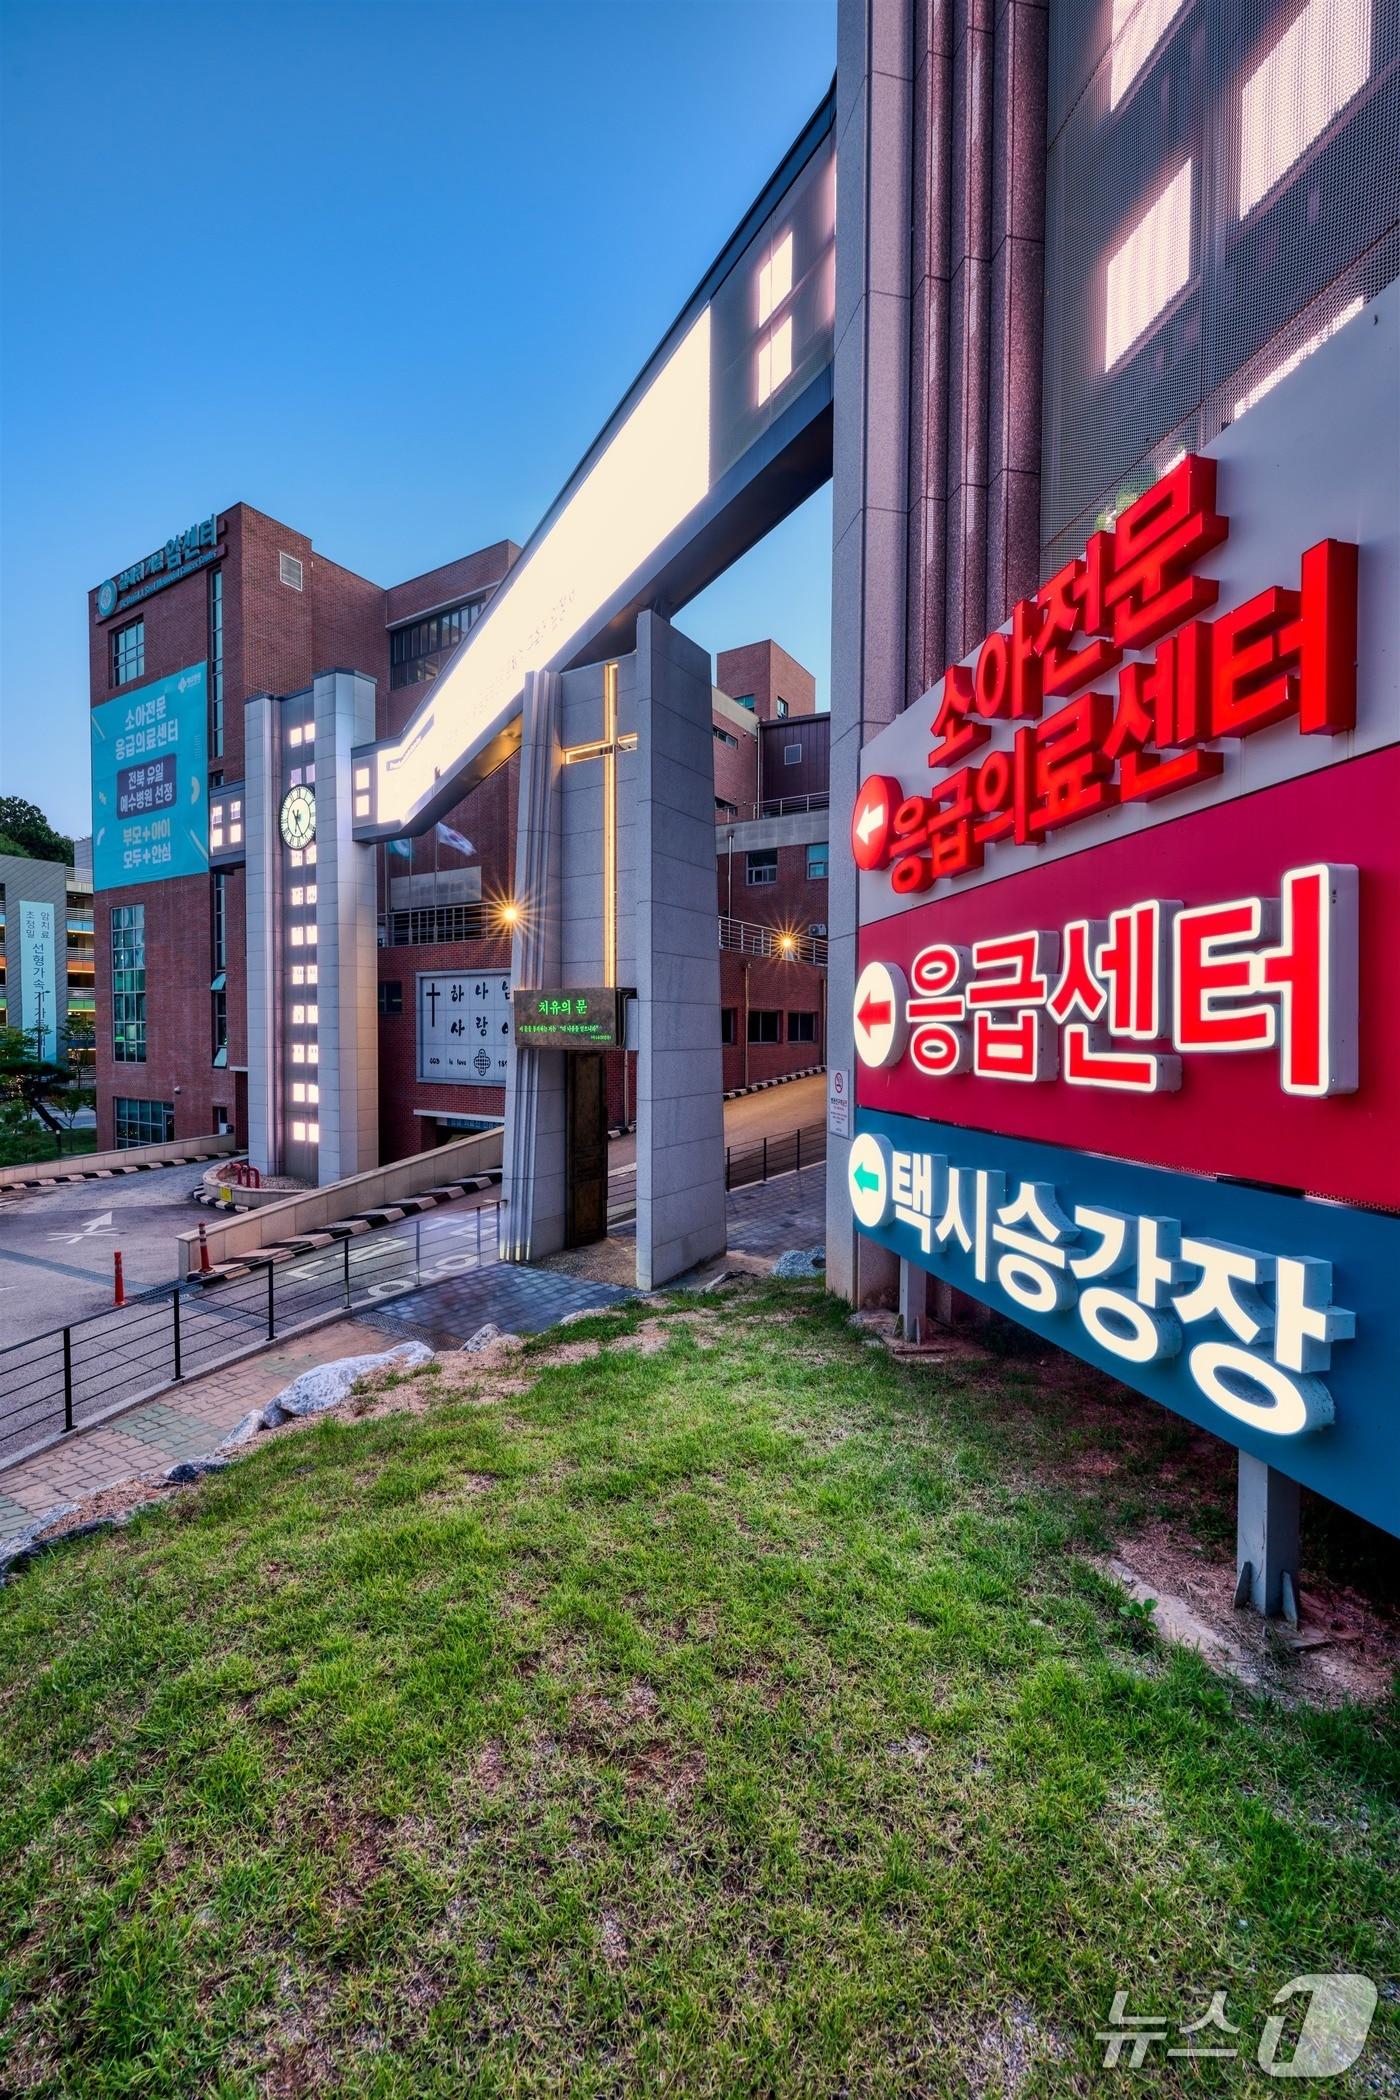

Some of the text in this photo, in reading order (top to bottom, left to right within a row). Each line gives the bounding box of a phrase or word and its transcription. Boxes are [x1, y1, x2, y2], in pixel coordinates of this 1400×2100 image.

[165, 513, 217, 569] 암센터
[929, 454, 1229, 767] 소아전문
[125, 695, 167, 732] 소아전문
[890, 538, 1359, 893] 응급의료센터
[115, 718, 179, 761] 응급의료센터
[128, 762, 164, 790] 전북 유일
[120, 783, 173, 813] 예수병원 선정
[123, 818, 171, 845] 부모+아이
[123, 843, 172, 869] 모두+안심
[26, 911, 36, 939] 초정밀
[41, 911, 50, 939] 암치료
[33, 943, 45, 1002] 선형가속기
[907, 864, 1345, 1096] 응급센터
[538, 999, 588, 1016] 치유의 문
[891, 1150, 1340, 1435] 택시승강장
